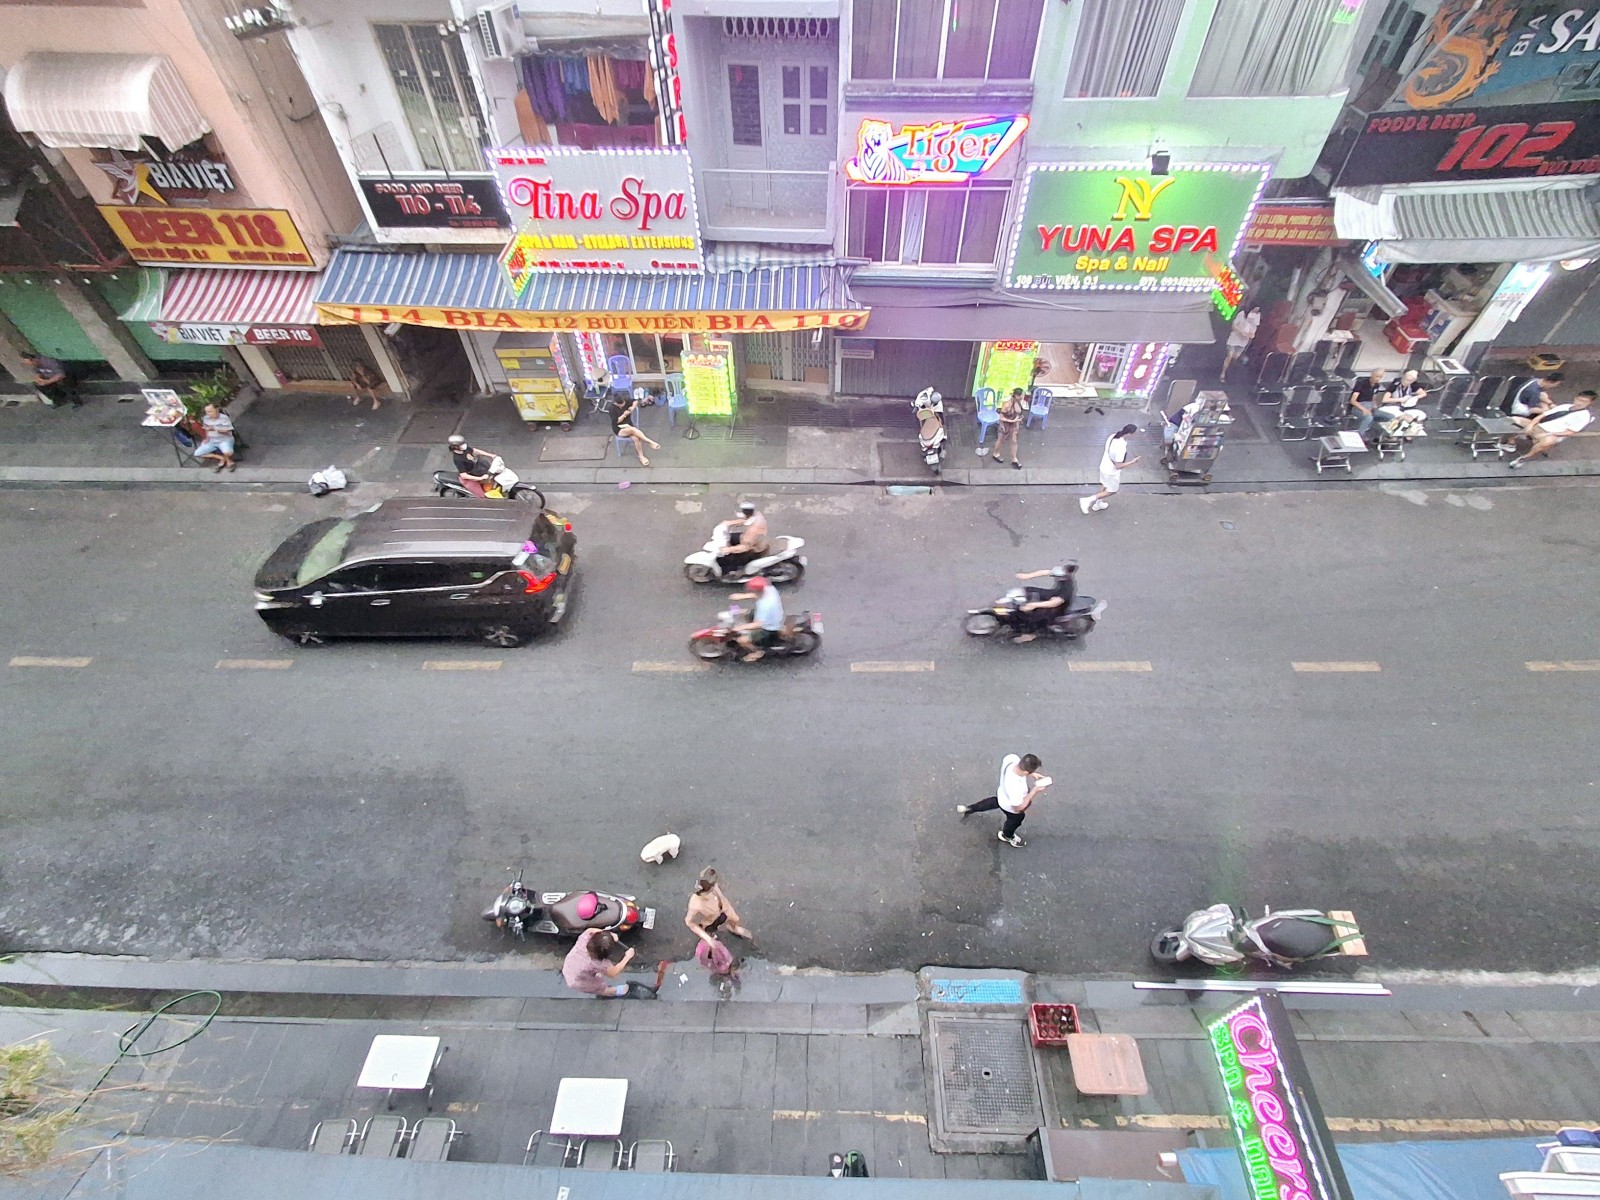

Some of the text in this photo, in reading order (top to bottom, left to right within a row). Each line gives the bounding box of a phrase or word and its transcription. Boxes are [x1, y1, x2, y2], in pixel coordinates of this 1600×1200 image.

[1508, 14, 1547, 57] BIA
[1536, 9, 1600, 53] SA
[902, 121, 1000, 172] Tiger
[1436, 121, 1575, 172] 102
[444, 195, 481, 215] 114
[508, 176, 687, 231] Tina Spa
[117, 209, 285, 247] BEER 118
[630, 235, 695, 250] EXTENSIONS
[1036, 224, 1218, 252] YUNA SPA
[1075, 256, 1110, 272] Spa
[1113, 256, 1129, 271] &
[178, 327, 199, 341] BIA
[199, 326, 226, 343] VIỆT
[254, 328, 291, 341] BEER
[347, 307, 863, 332] 114 BIA 112 BÙI VIỆN BIA 110
